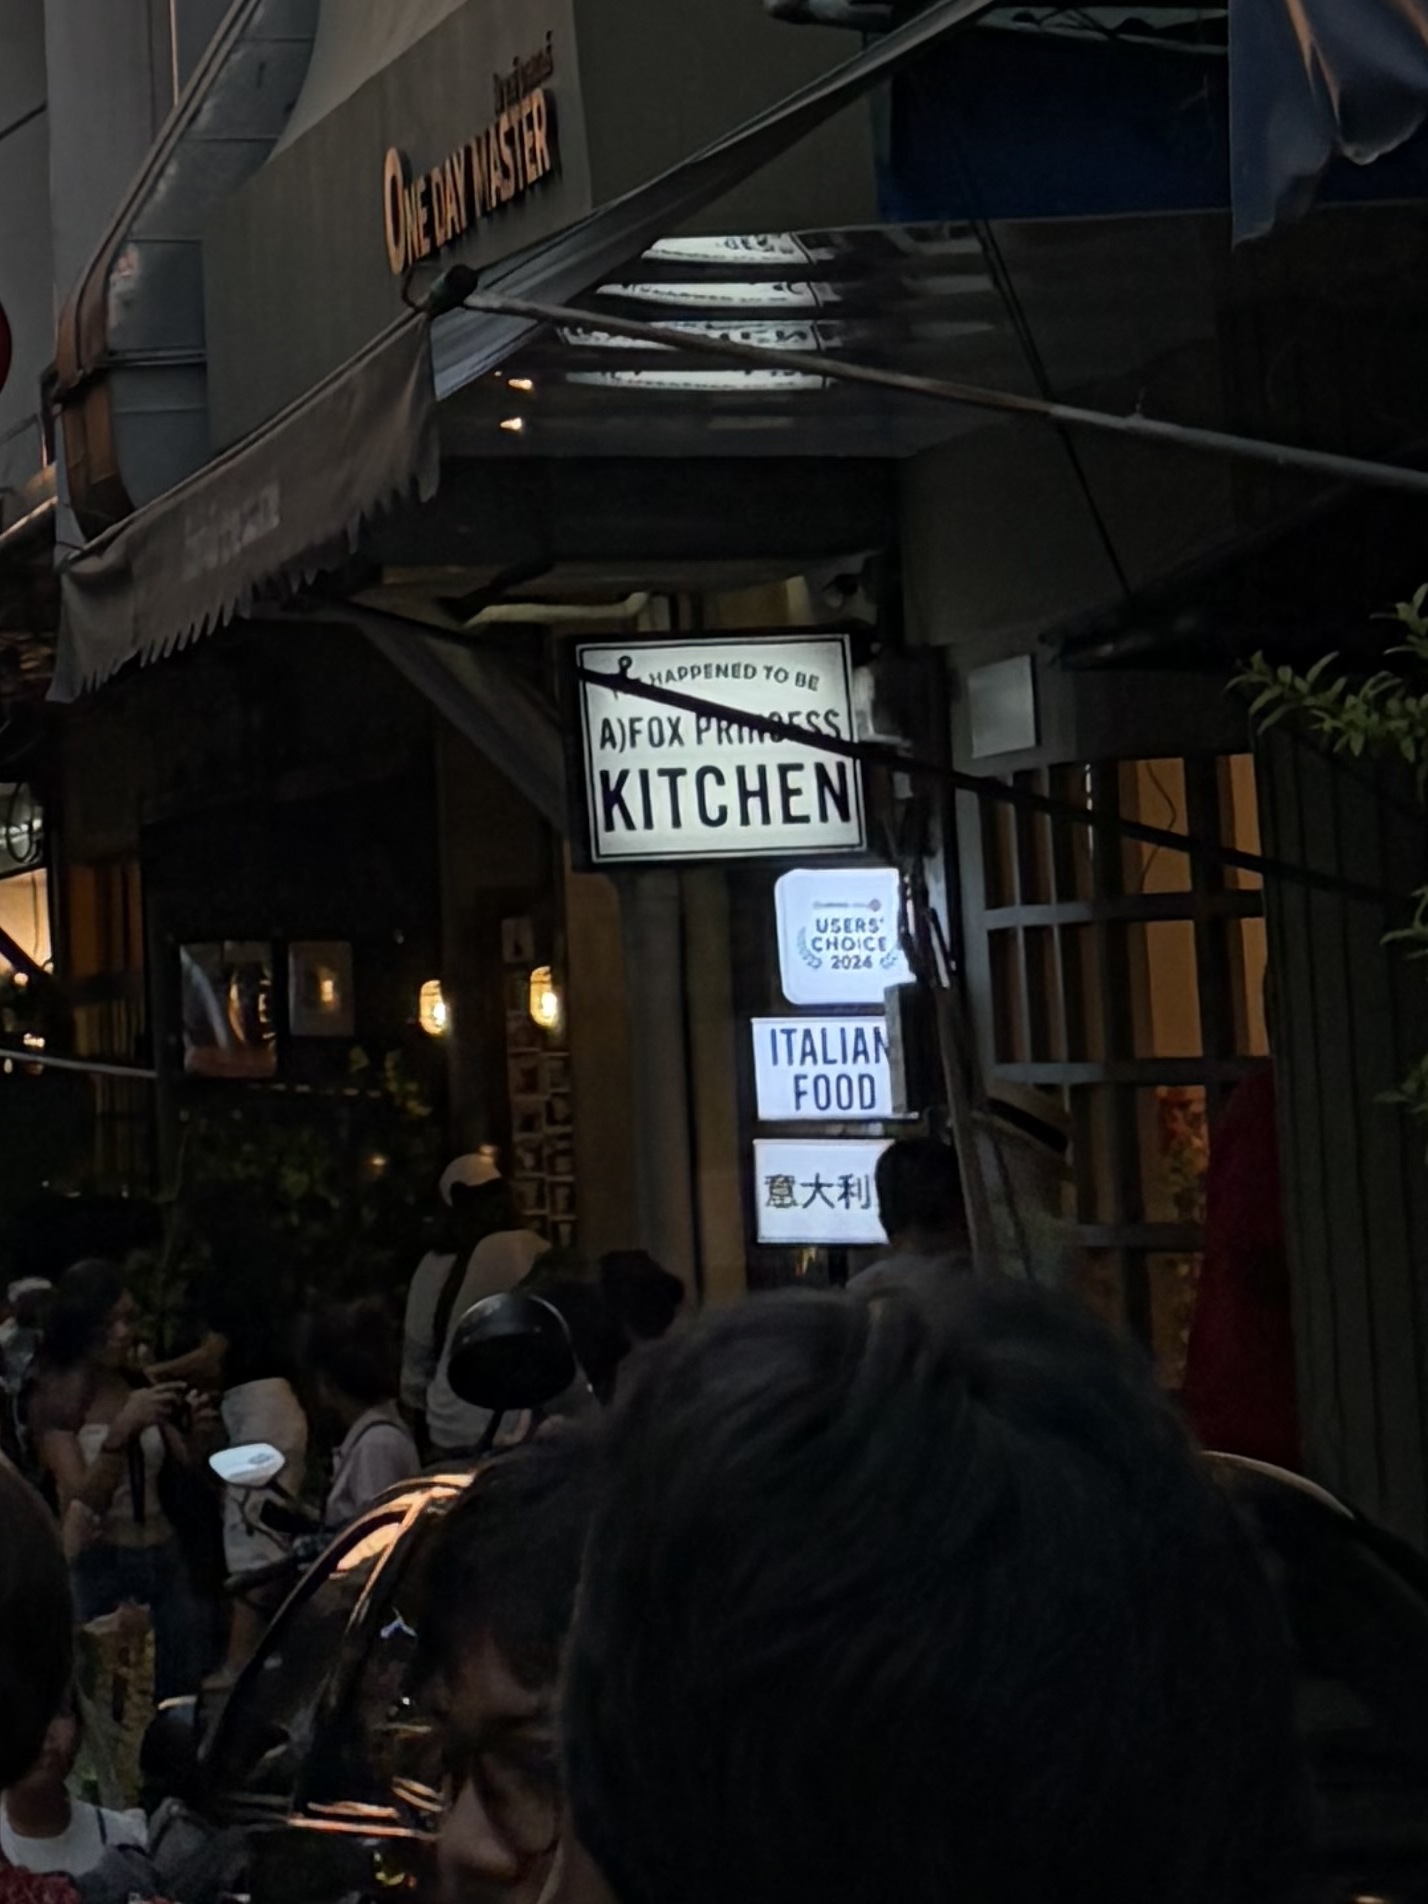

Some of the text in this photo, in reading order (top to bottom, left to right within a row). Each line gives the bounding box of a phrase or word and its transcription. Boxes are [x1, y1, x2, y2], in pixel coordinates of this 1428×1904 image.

[648, 661, 758, 688] HAPPENED
[762, 663, 790, 685] TO
[794, 670, 821, 692] BE
[599, 715, 685, 754] A)FOX
[598, 760, 851, 833] KITCHEN
[810, 936, 888, 953] CHOICE
[830, 955, 874, 971] 2024
[793, 1073, 877, 1112] FOOD
